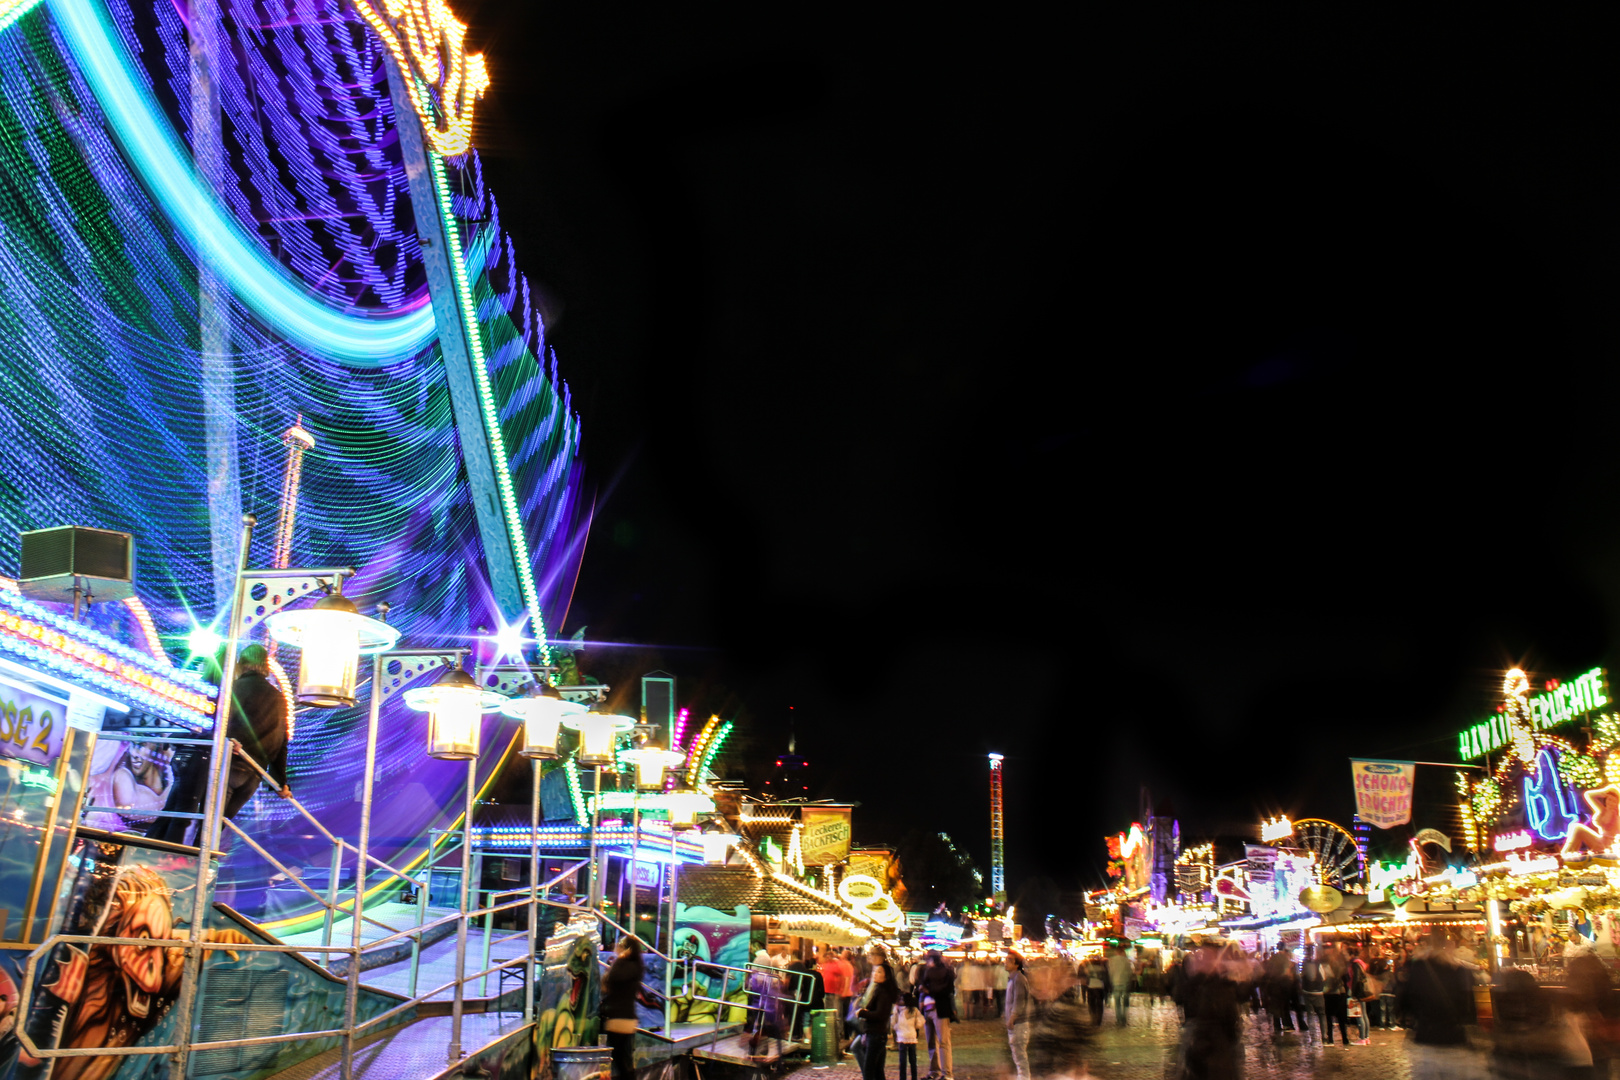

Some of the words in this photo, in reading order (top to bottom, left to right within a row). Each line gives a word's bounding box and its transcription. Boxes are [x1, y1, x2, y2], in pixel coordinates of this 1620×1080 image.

[1528, 667, 1608, 732] FRÜCHTE
[31, 709, 53, 755] 2
[1358, 791, 1410, 814] FRÜCHTE
[803, 825, 850, 850] BACKFISCH
[810, 821, 843, 837] Leckerer
